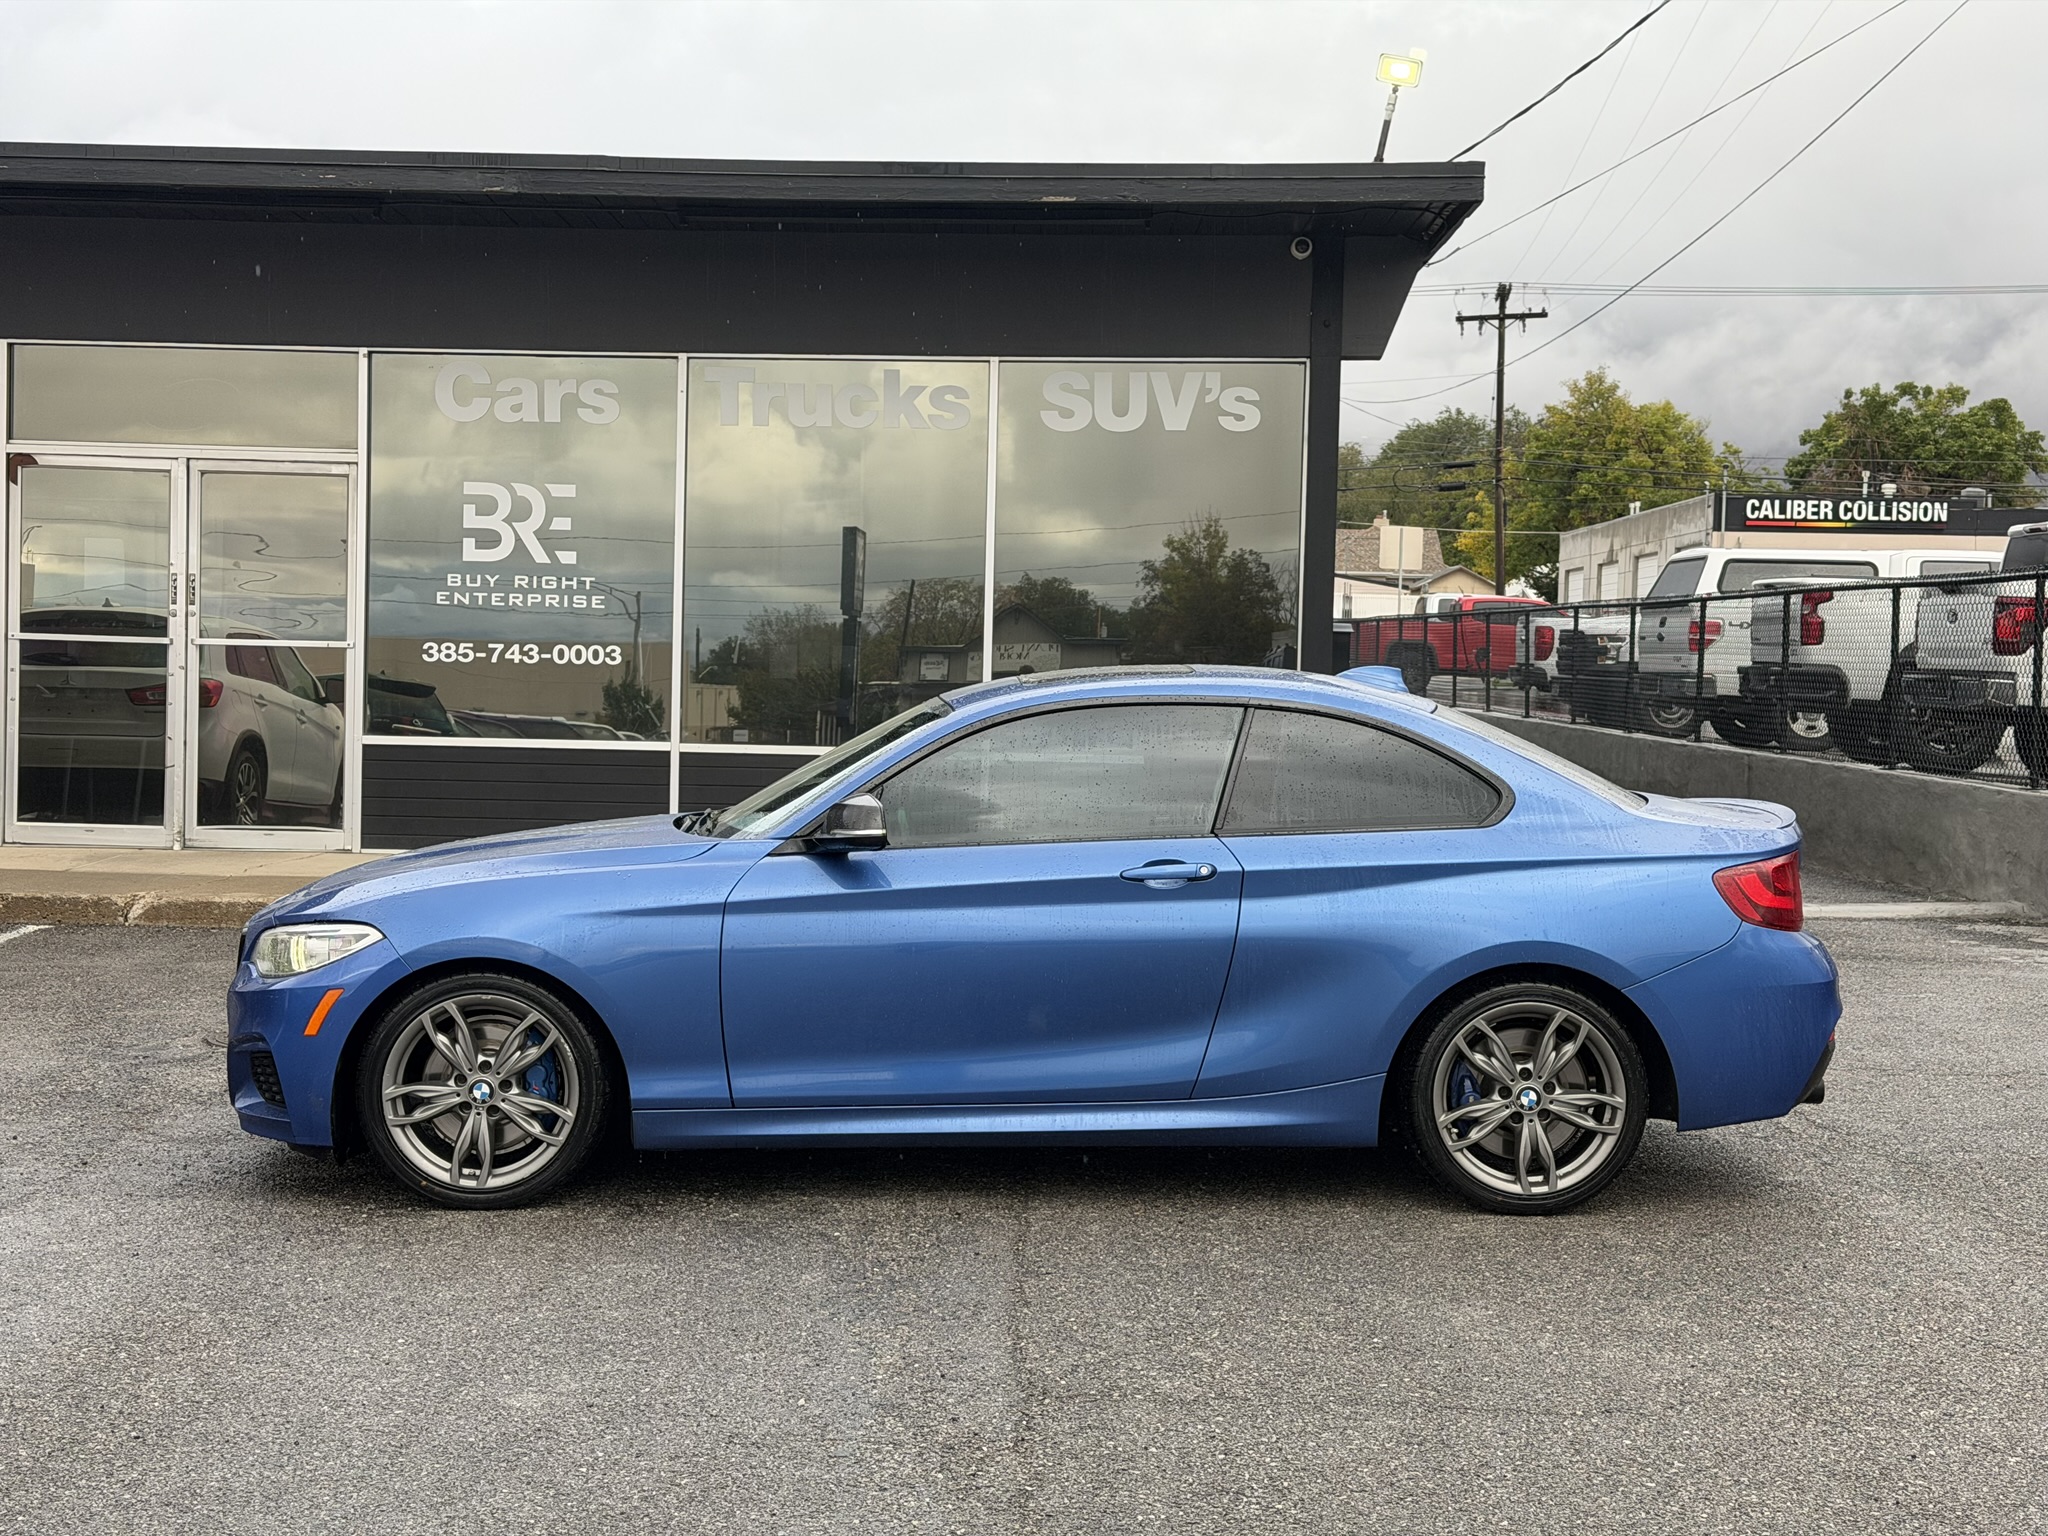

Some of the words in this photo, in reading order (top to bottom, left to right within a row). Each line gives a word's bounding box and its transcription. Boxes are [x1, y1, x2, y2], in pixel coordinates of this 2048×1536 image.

[434, 360, 620, 425] Cars
[703, 366, 971, 430] Trucks
[1040, 371, 1261, 432] SUV's
[462, 481, 577, 565] BRE
[1745, 499, 1834, 520] CALIBER
[1838, 500, 1949, 522] COLLISION
[436, 591, 606, 608] ENTERPRISE
[446, 573, 501, 588] BUY
[513, 575, 596, 590] RIGHT
[421, 641, 623, 665] 385-743-0003
